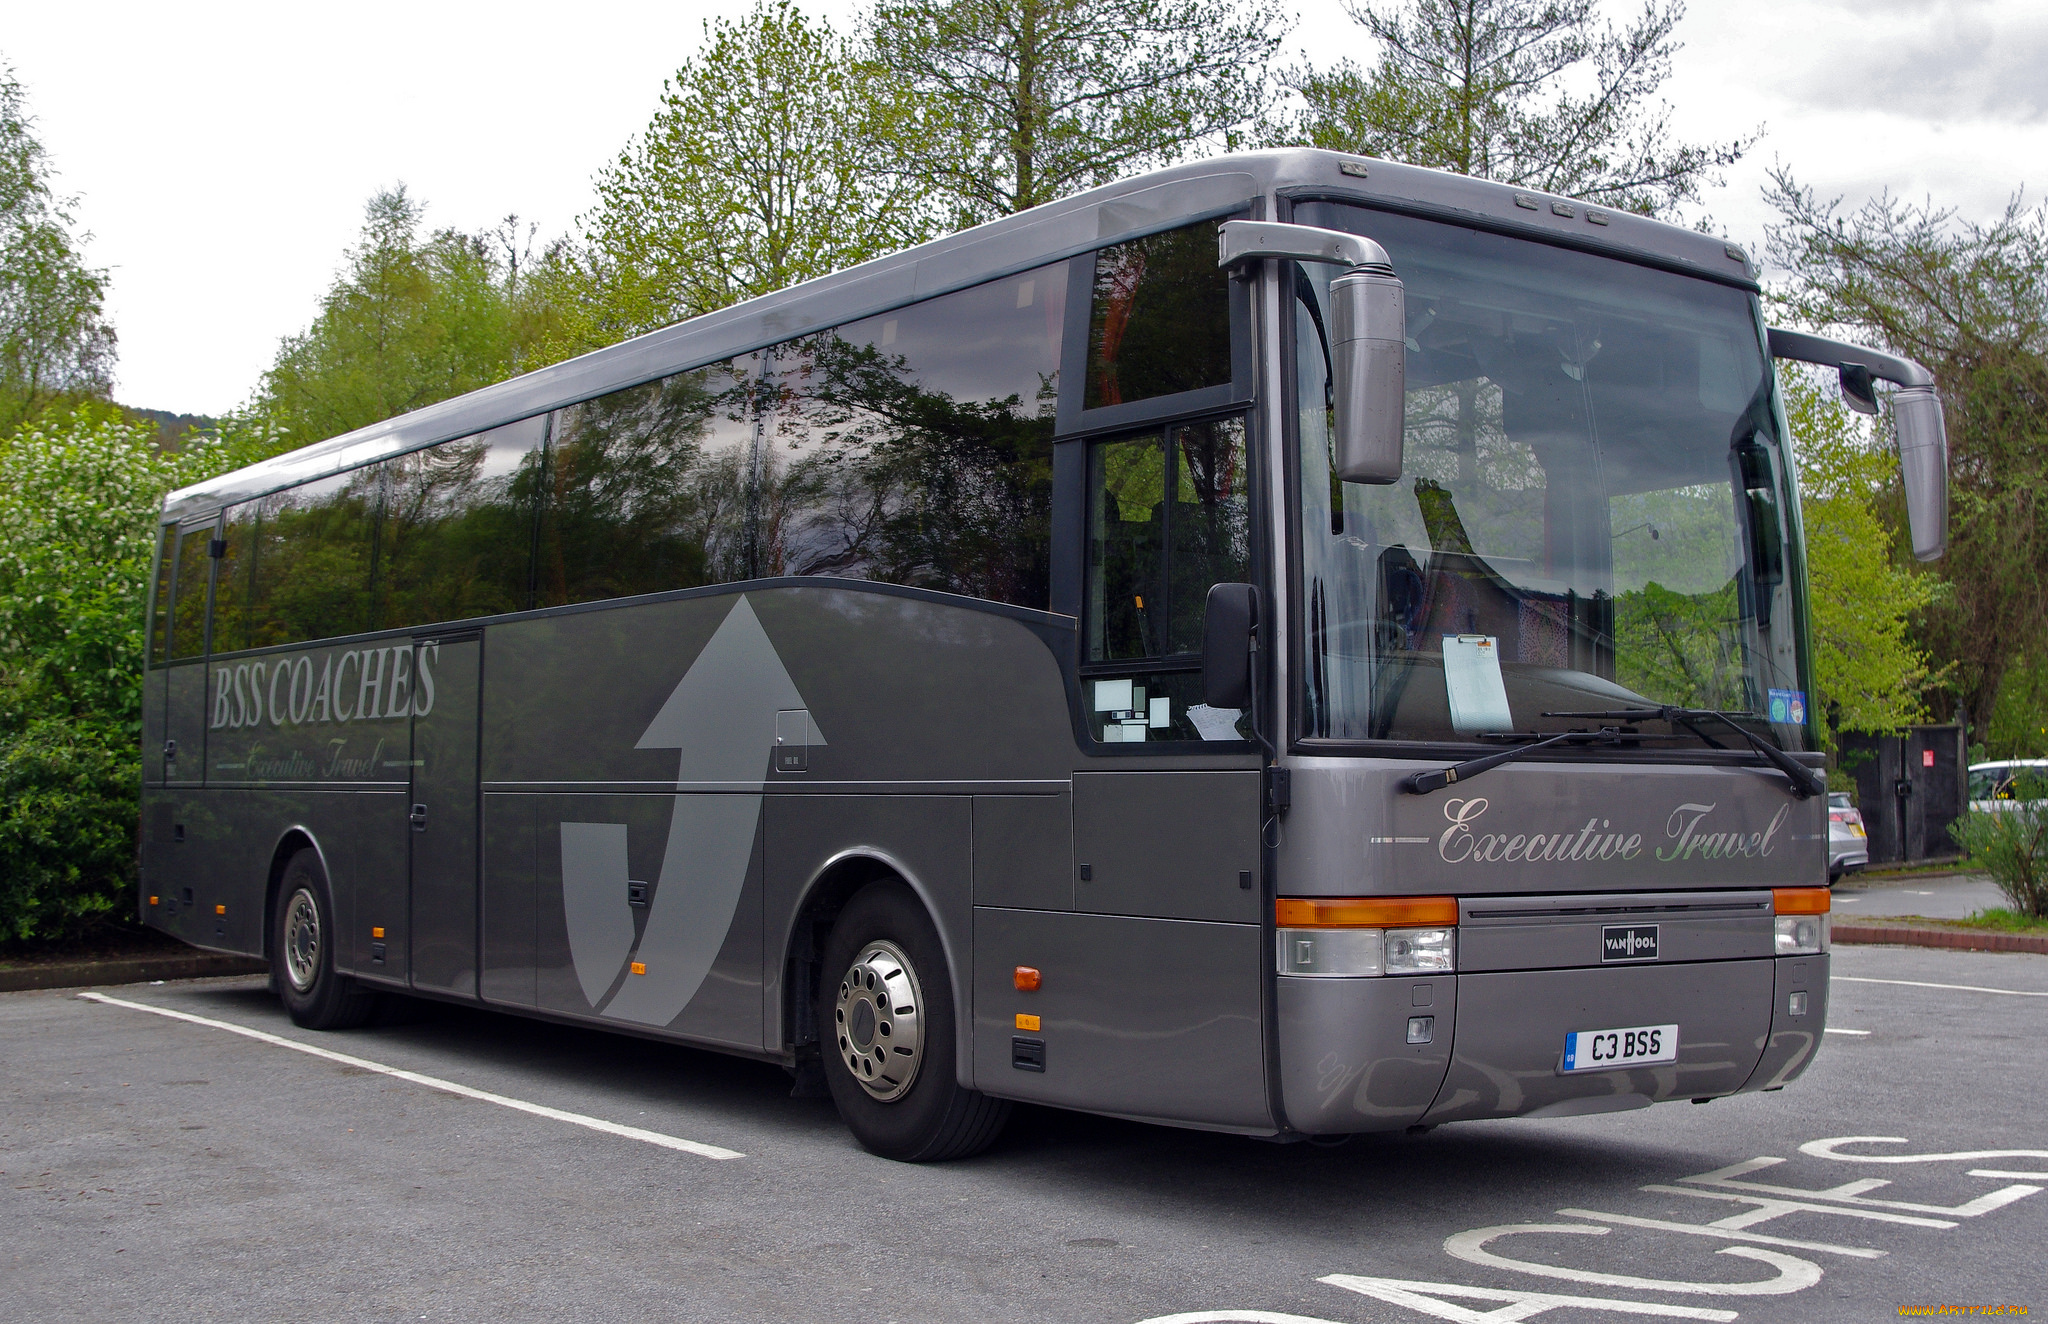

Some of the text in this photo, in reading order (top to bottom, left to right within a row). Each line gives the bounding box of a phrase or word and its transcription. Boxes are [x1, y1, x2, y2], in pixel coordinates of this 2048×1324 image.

[210, 639, 440, 729] BSS COACHES
[246, 737, 385, 778] Executive Travel
[1438, 797, 1790, 864] Executive Travel
[1566, 1054, 1575, 1062] GB
[1592, 1029, 1662, 1061] C3 BSS
